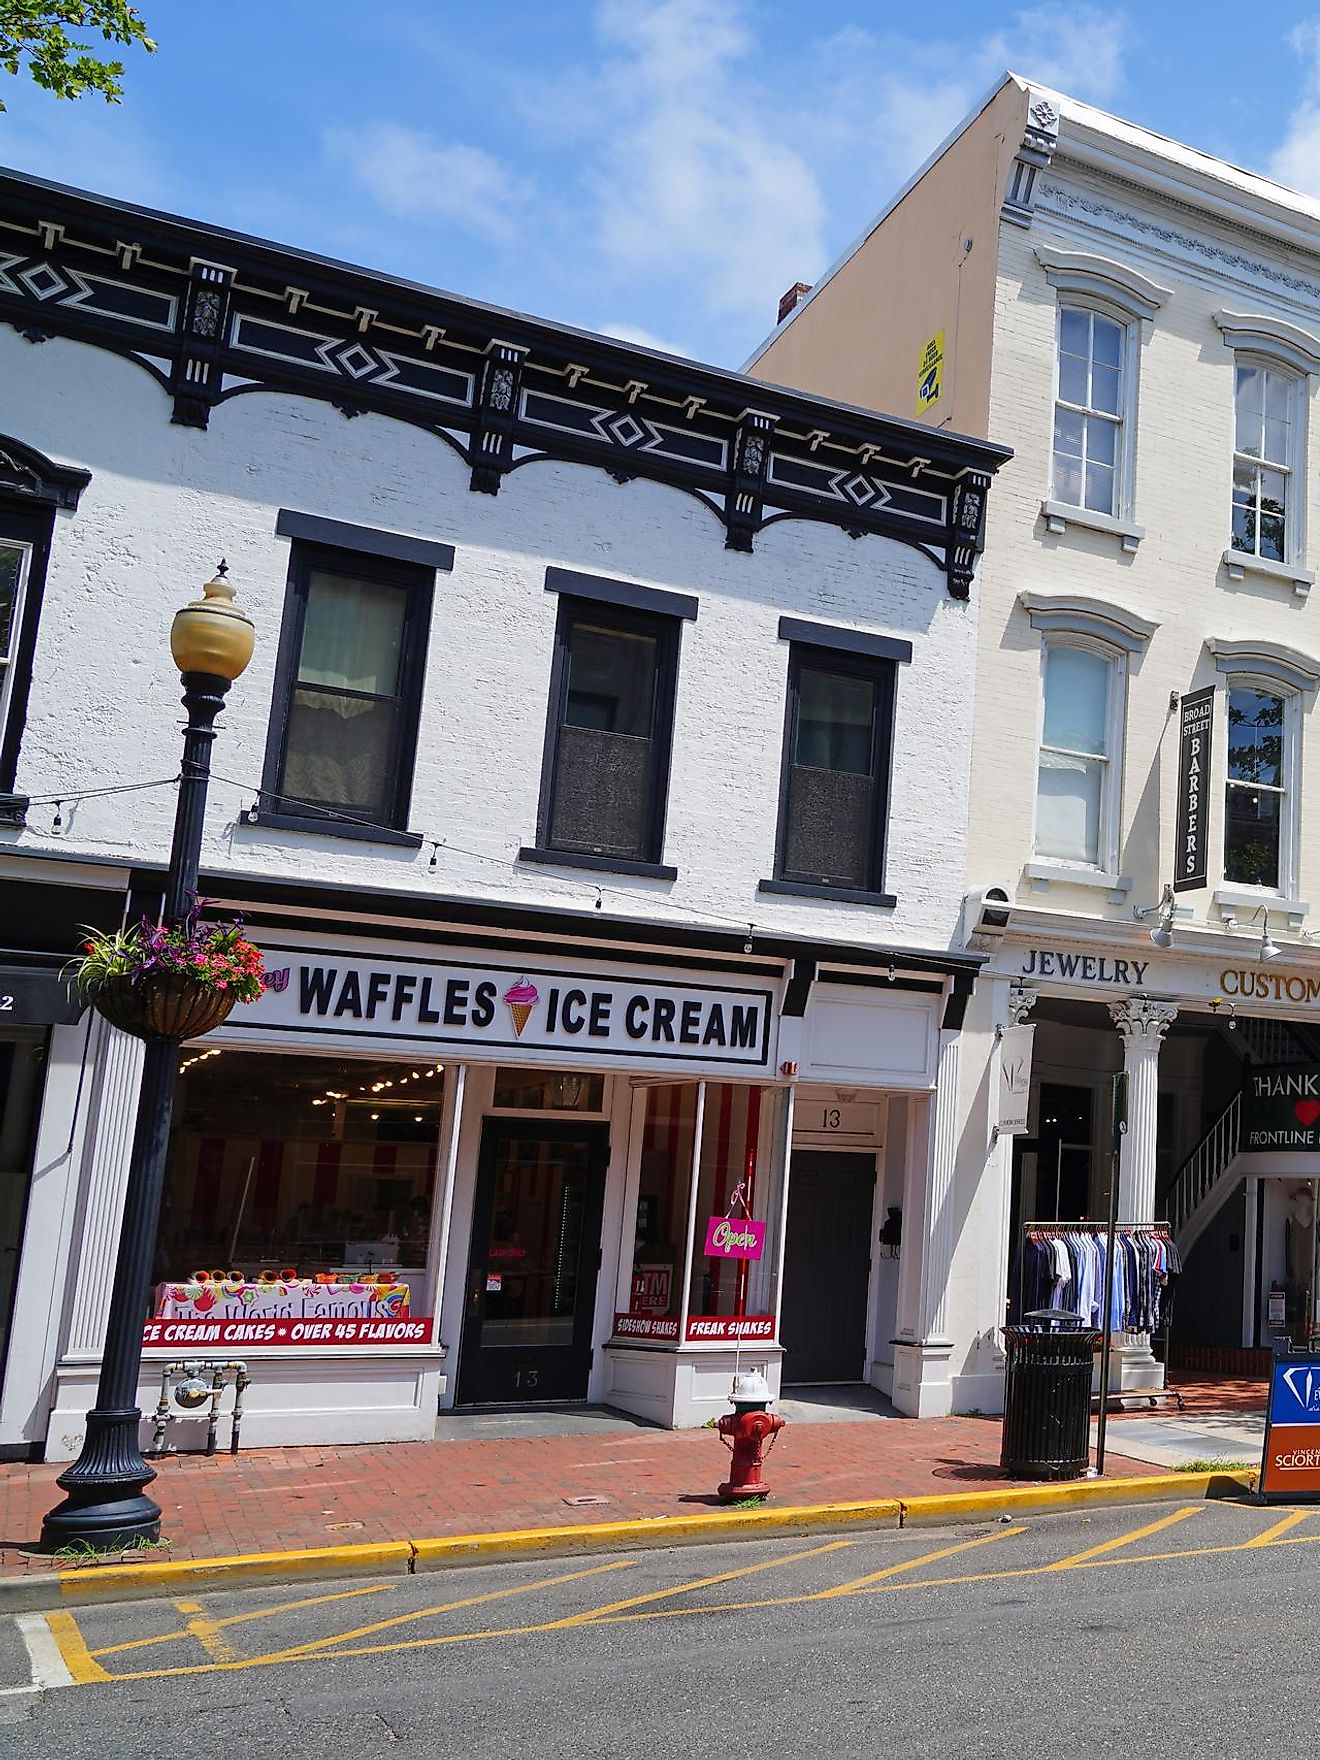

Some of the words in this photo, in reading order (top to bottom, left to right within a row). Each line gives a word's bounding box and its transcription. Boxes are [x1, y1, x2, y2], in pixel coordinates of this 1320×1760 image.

[1184, 704, 1211, 722] BROAD
[1183, 719, 1210, 737] STREET
[1186, 738, 1201, 874] BARBERS
[1022, 950, 1149, 985] JEWELRY
[259, 967, 290, 992] ey
[300, 966, 497, 1028] WAFFLES
[546, 988, 613, 1035] ICE
[625, 994, 759, 1049] CREAM
[1253, 1074, 1319, 1096] THANK
[822, 1109, 841, 1128] 13
[1250, 1130, 1315, 1145] FRONTLINE
[713, 1221, 757, 1253] Open
[142, 1324, 161, 1342] CE
[164, 1324, 221, 1341] CREAM
[223, 1324, 276, 1340] CAKES
[290, 1323, 333, 1340] OVER
[334, 1323, 356, 1340] 45
[359, 1322, 425, 1339] FLAVORS
[617, 1318, 652, 1334] SIDESHOW
[651, 1320, 678, 1336] SHAKES
[689, 1321, 726, 1336] FREAK
[727, 1320, 772, 1335] SHAKES
